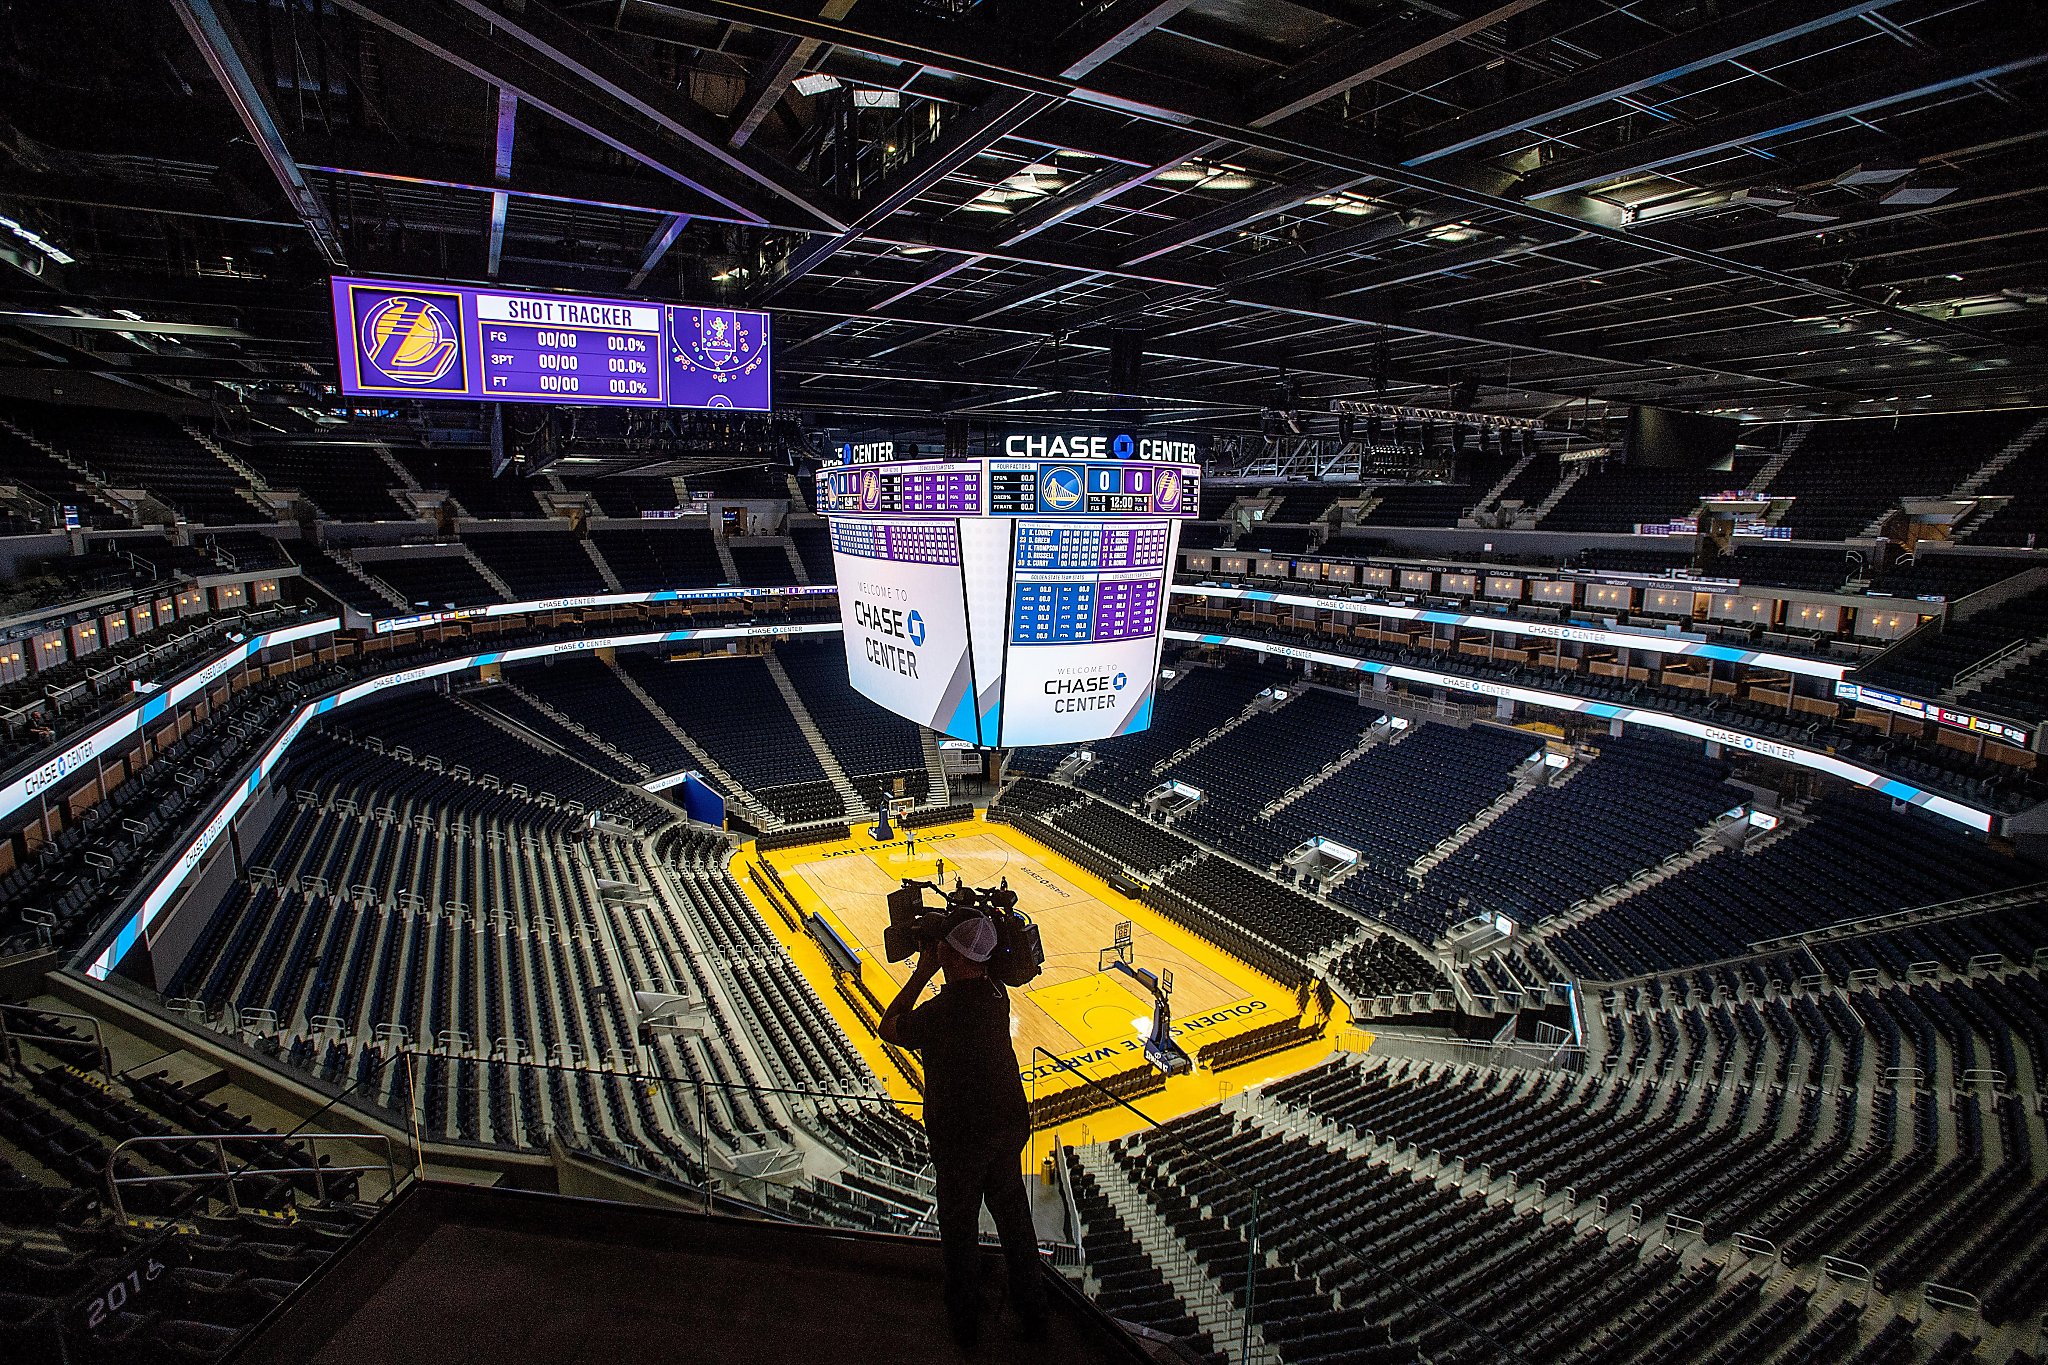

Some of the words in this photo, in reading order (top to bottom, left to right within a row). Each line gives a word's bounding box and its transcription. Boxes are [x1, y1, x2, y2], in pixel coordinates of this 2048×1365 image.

[509, 300, 553, 320] SHOT
[558, 304, 632, 326] TRACKER
[490, 331, 507, 342] FG
[538, 331, 577, 348] 00/00
[608, 336, 646, 352] 00.0%
[491, 354, 514, 365] 3PT
[539, 354, 578, 371] 00/00
[608, 358, 646, 374] 00.0%
[493, 377, 508, 386] FT
[540, 376, 579, 392] 00/00
[609, 379, 647, 394] 00.0%
[853, 442, 894, 463] CENTER
[1006, 435, 1108, 458] CHASE
[1139, 439, 1196, 463] CENTER
[1100, 471, 1109, 490] 0
[1134, 472, 1143, 491] 0
[1110, 497, 1133, 508] 12:00
[858, 582, 892, 598] WELCOME
[896, 588, 907, 601] TO
[1606, 578, 1627, 586] verizon
[538, 600, 562, 609] CHASE
[570, 597, 596, 606] CENTER
[1316, 599, 1338, 609] CHASE
[1345, 603, 1367, 612] CENTER
[855, 600, 905, 639] CHASE
[1528, 625, 1560, 636] CHASE
[1572, 631, 1606, 642] CENTER
[554, 642, 577, 652] CHASE
[586, 639, 612, 648] CENTER
[1266, 645, 1285, 654] CHASE
[866, 637, 919, 679] CENTER
[374, 676, 394, 688] CHASE
[403, 670, 426, 680] CENTER
[1058, 665, 1102, 675] WELCOME
[1044, 676, 1110, 694] CHASE
[1442, 677, 1471, 689] CHASE
[1480, 685, 1511, 696] CENTER
[1054, 694, 1116, 713] CENTER
[1705, 729, 1741, 745] CHASE
[1756, 741, 1795, 759] CENTER
[25, 763, 58, 796] CHASE
[67, 741, 94, 768] CENTER
[186, 838, 203, 868] CHASE
[821, 849, 857, 858] SAN
[1046, 884, 1070, 898] CHASE
[1184, 1000, 1267, 1032] GOLDEN
[1019, 1047, 1120, 1082] WARRIO
[86, 1270, 140, 1328] 201
